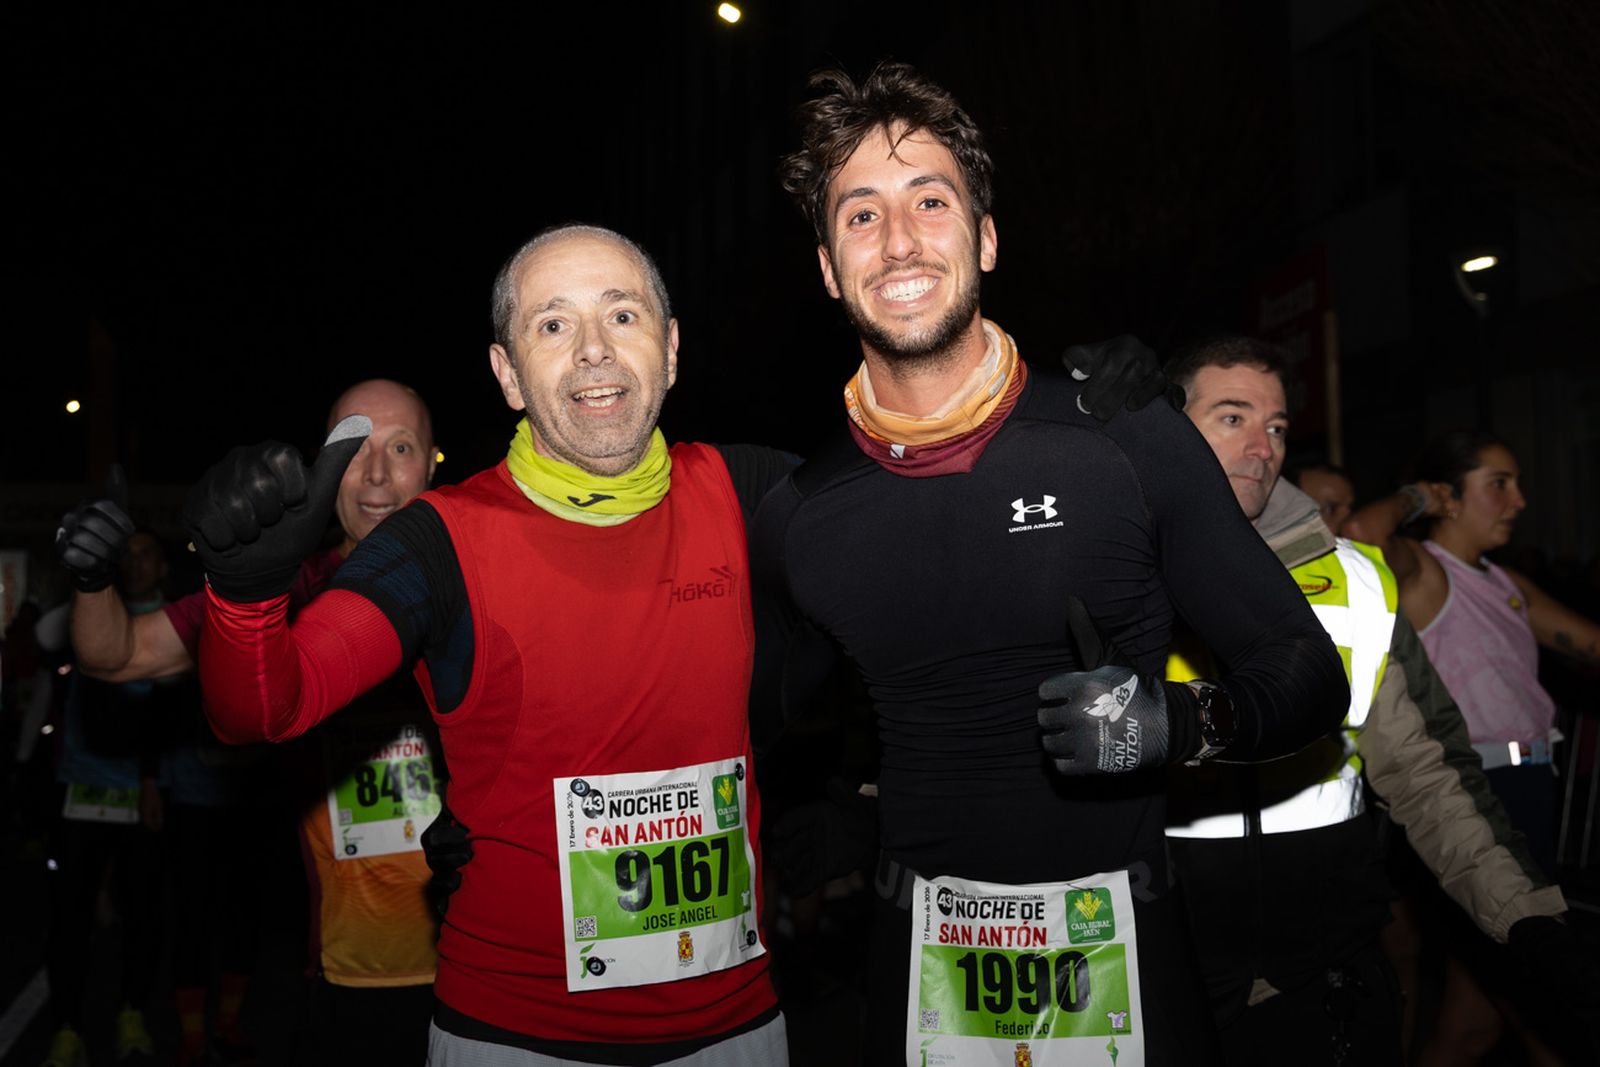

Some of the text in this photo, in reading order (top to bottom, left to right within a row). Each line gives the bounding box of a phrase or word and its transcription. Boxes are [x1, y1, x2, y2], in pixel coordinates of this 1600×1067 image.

[1008, 521, 1064, 533] UNDER ARMOUR
[1115, 686, 1131, 708] 43
[608, 789, 634, 798] CARRERA
[635, 786, 657, 796] URBANA
[582, 796, 604, 811] 43
[609, 793, 673, 819] NOCHE
[677, 790, 699, 810] DE
[568, 810, 574, 819] de
[585, 810, 703, 849] SAN ANTÓN
[615, 837, 729, 913] 9167
[924, 904, 930, 913] de
[938, 893, 953, 909] 43
[956, 900, 1045, 920] NOCHE DE
[642, 906, 719, 931] JOSE ANGEL
[924, 933, 930, 941] 17
[939, 920, 1047, 948] SAN ANTÓN
[956, 950, 1091, 1015] 1990
[995, 1020, 1050, 1036] Federico
